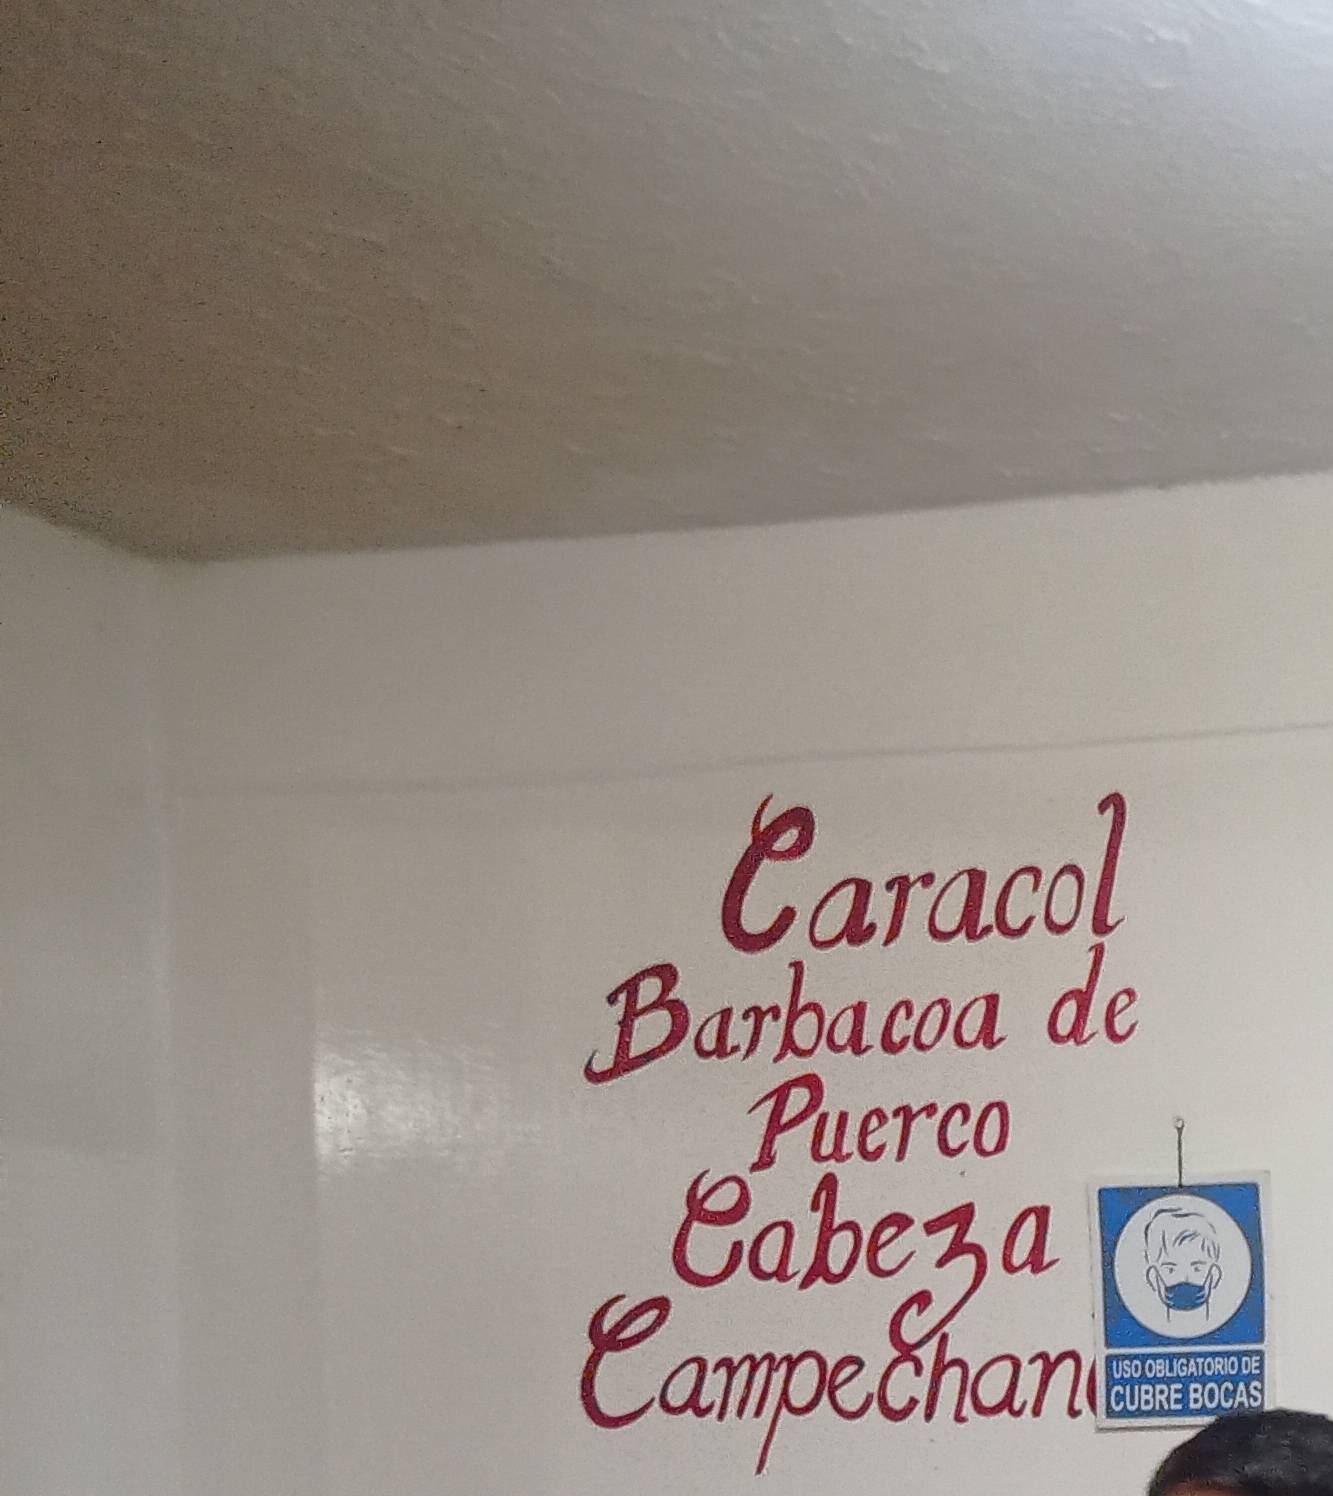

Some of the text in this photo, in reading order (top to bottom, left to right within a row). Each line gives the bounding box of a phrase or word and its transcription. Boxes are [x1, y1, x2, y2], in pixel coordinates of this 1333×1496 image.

[720, 791, 1127, 954] Caracol
[583, 942, 1140, 1085] Barbacoa de
[747, 1071, 1010, 1173] Puerco
[671, 1168, 1061, 1348] Cabeza
[578, 1294, 1098, 1476] Campechan
[1110, 1381, 1263, 1413] CUBRE BOCAS
[1112, 1355, 1261, 1380] USO OBLIGATORIO DE
